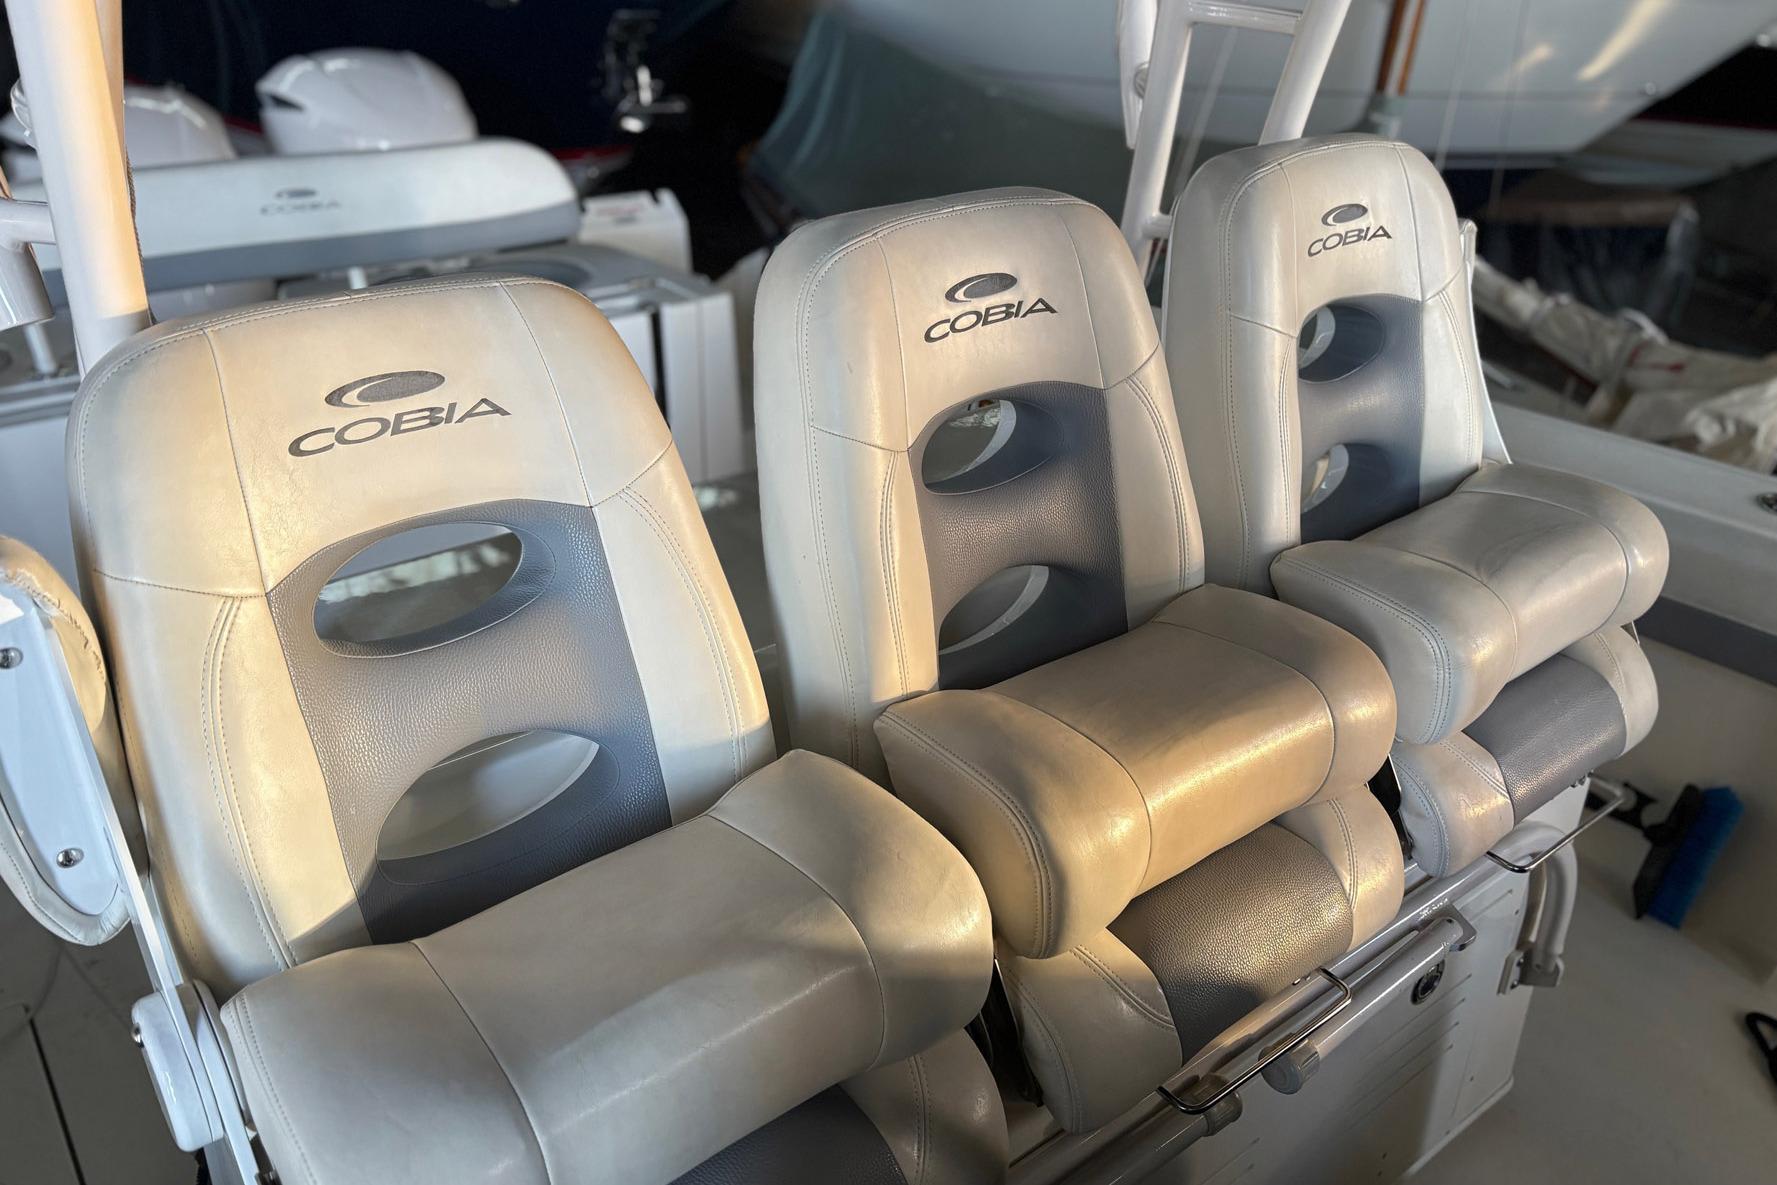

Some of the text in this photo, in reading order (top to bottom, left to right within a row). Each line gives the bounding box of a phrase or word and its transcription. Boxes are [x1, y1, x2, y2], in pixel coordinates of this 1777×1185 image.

[1307, 225, 1392, 257] COBIA
[923, 297, 1059, 343] COBIA
[288, 397, 512, 457] COBIA
